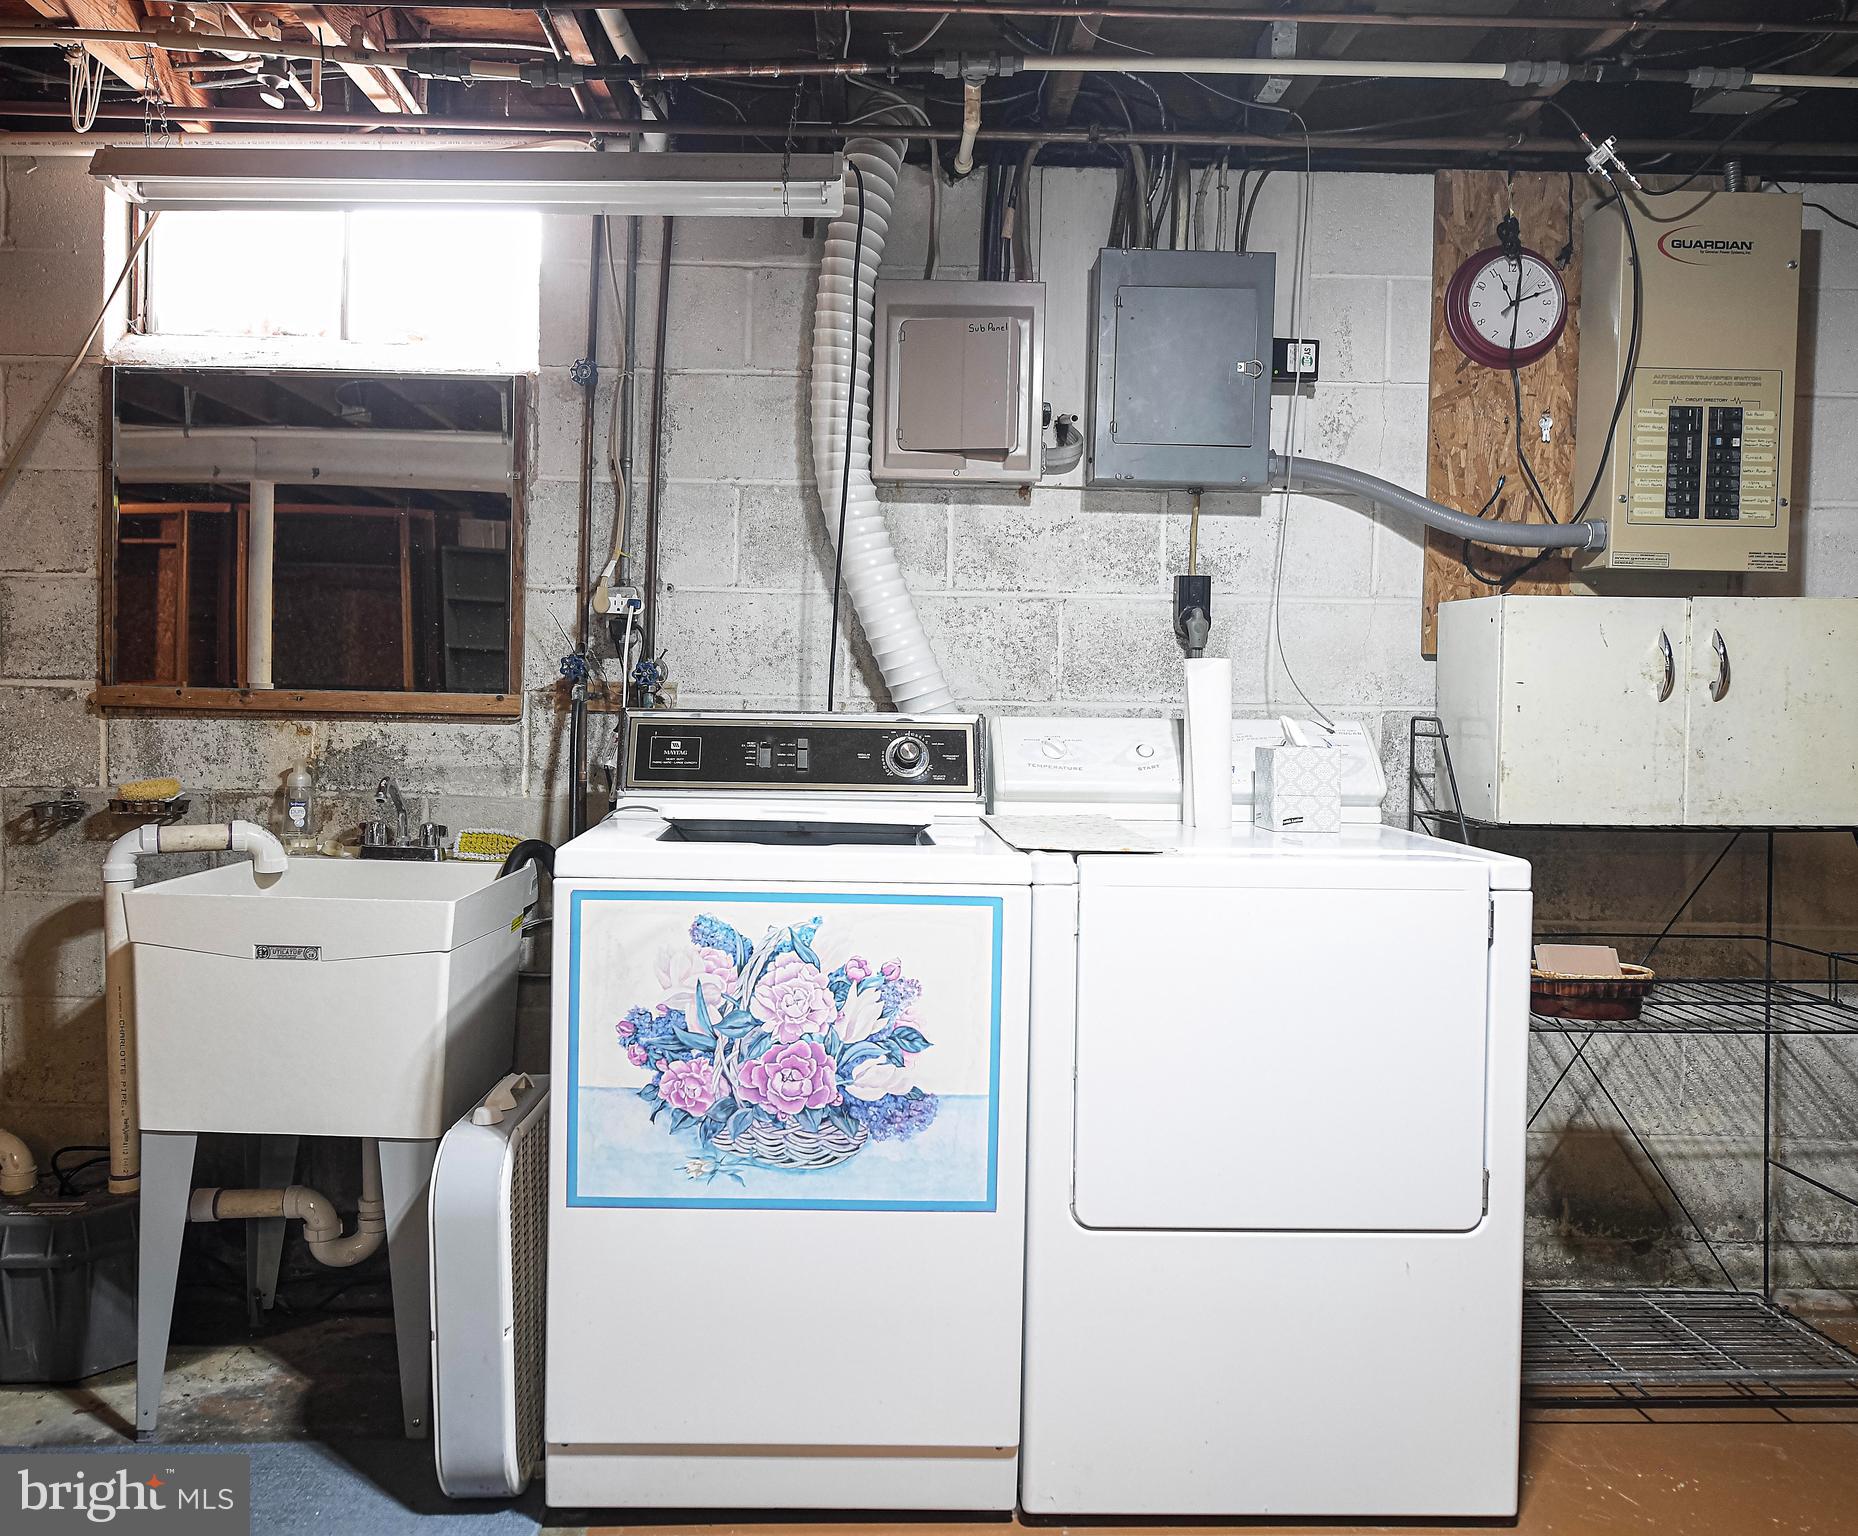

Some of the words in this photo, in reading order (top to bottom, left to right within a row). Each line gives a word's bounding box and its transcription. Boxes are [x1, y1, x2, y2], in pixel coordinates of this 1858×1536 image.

[1671, 239, 1753, 251] GUARDIAN
[1508, 263, 1517, 273] 12
[1489, 268, 1499, 279] 11
[1476, 281, 1487, 291] 10
[1537, 280, 1546, 289] 2
[968, 323, 986, 333] Sub
[987, 322, 1008, 332] Panel
[1476, 318, 1486, 327] 8
[1491, 330, 1499, 339] 7
[1525, 328, 1534, 339] 5
[1027, 763, 1083, 771] TEMPERATURE
[119, 1020, 127, 1075] CHARLOTTE
